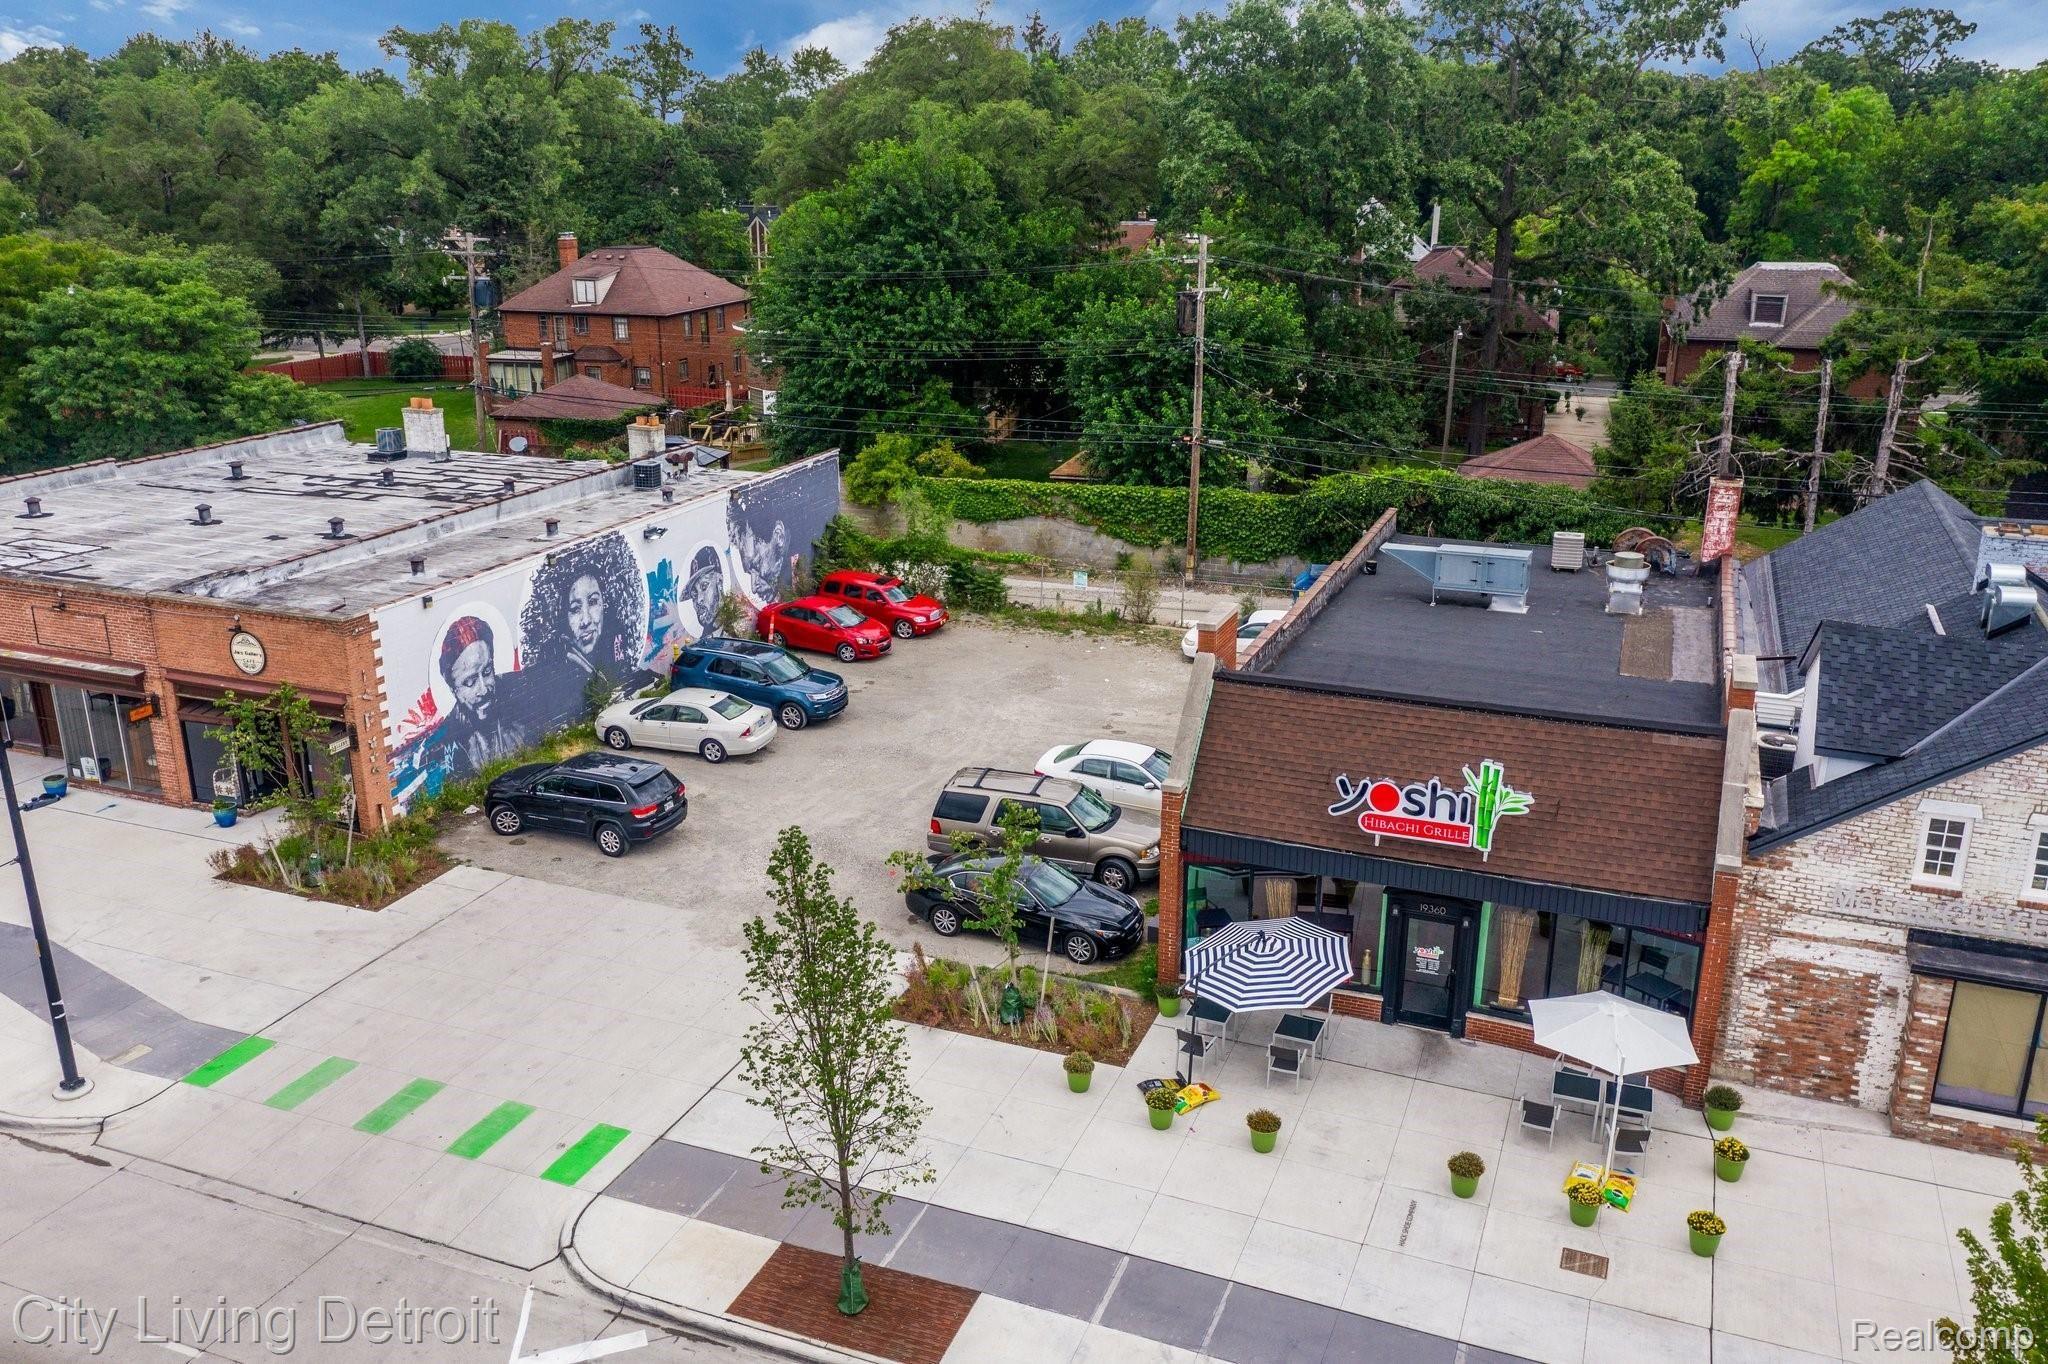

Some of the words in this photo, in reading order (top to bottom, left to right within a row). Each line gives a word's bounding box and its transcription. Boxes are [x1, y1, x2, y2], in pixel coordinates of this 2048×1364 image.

[1363, 816, 1420, 834] HIBACHI
[1423, 824, 1469, 842] GRILLE
[1420, 903, 1447, 916] 19360
